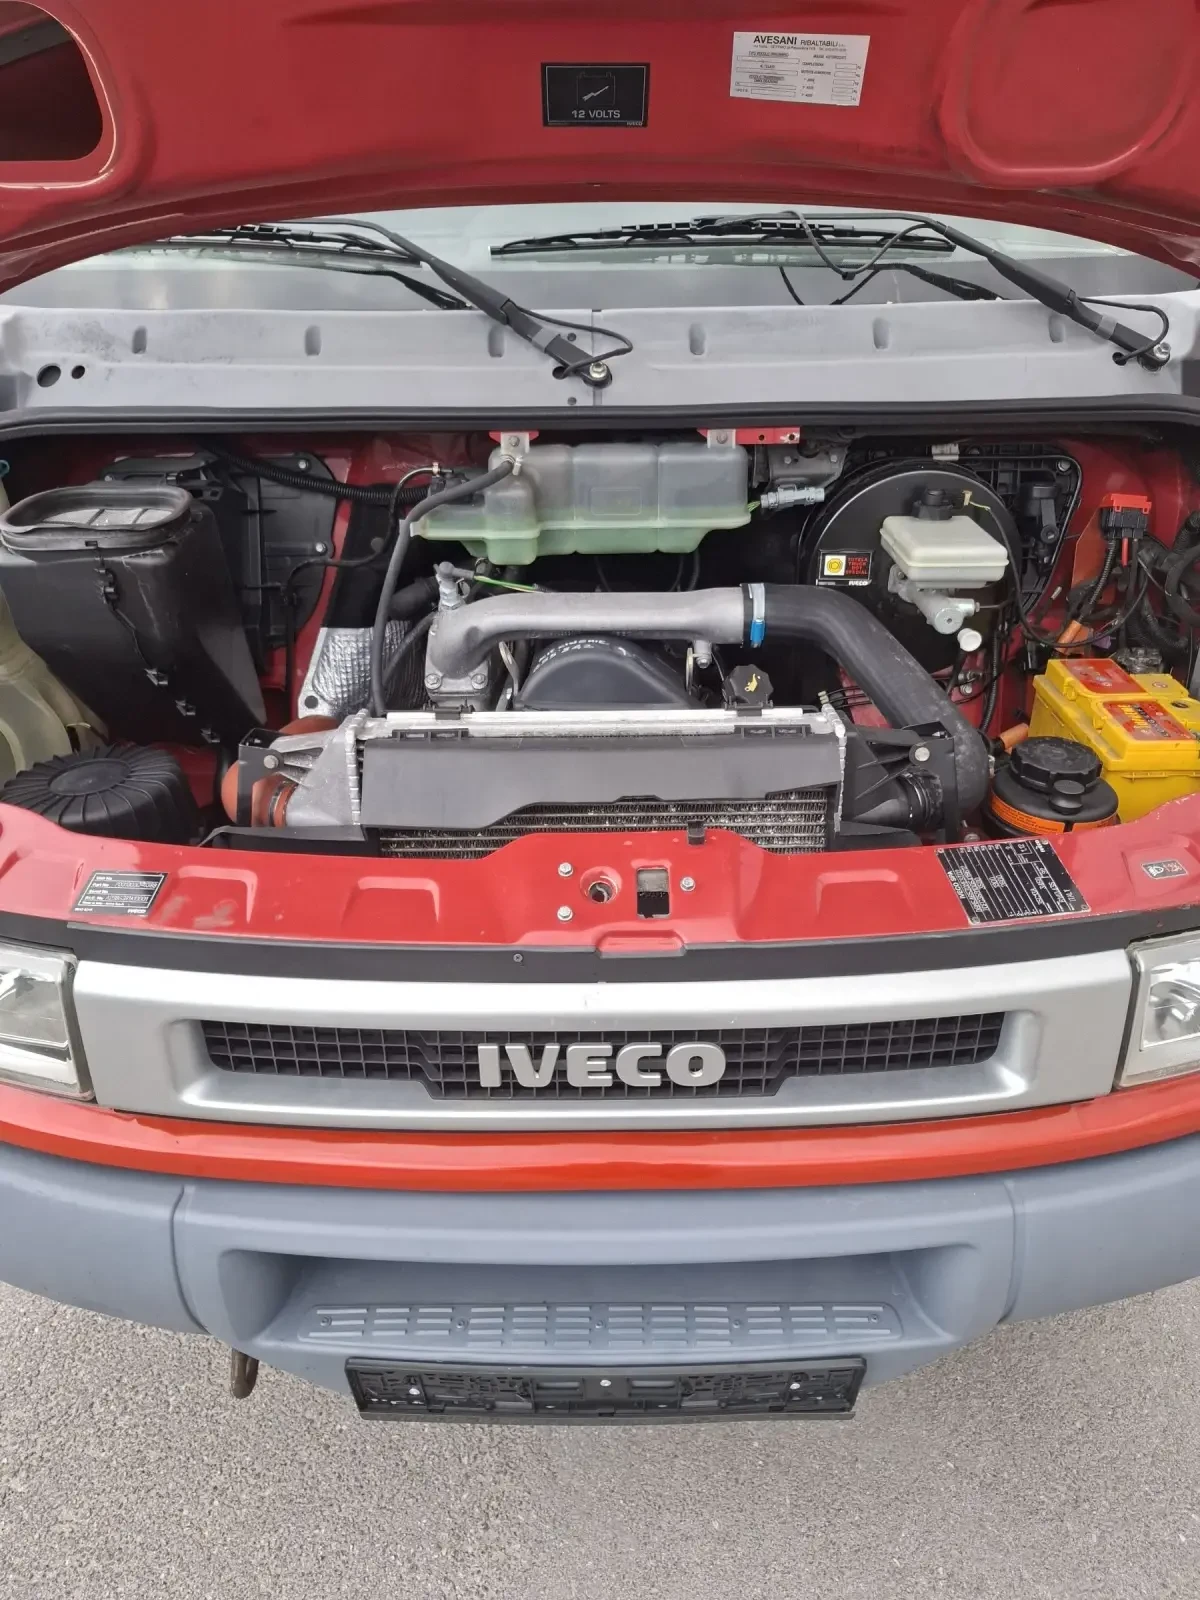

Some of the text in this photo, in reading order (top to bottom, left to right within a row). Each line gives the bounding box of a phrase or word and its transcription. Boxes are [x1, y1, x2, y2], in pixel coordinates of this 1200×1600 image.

[753, 35, 797, 45] AVESANI
[571, 110, 620, 118] 12 VOLTS
[953, 882, 966, 899] IVECO
[477, 1042, 726, 1088] IVECO
